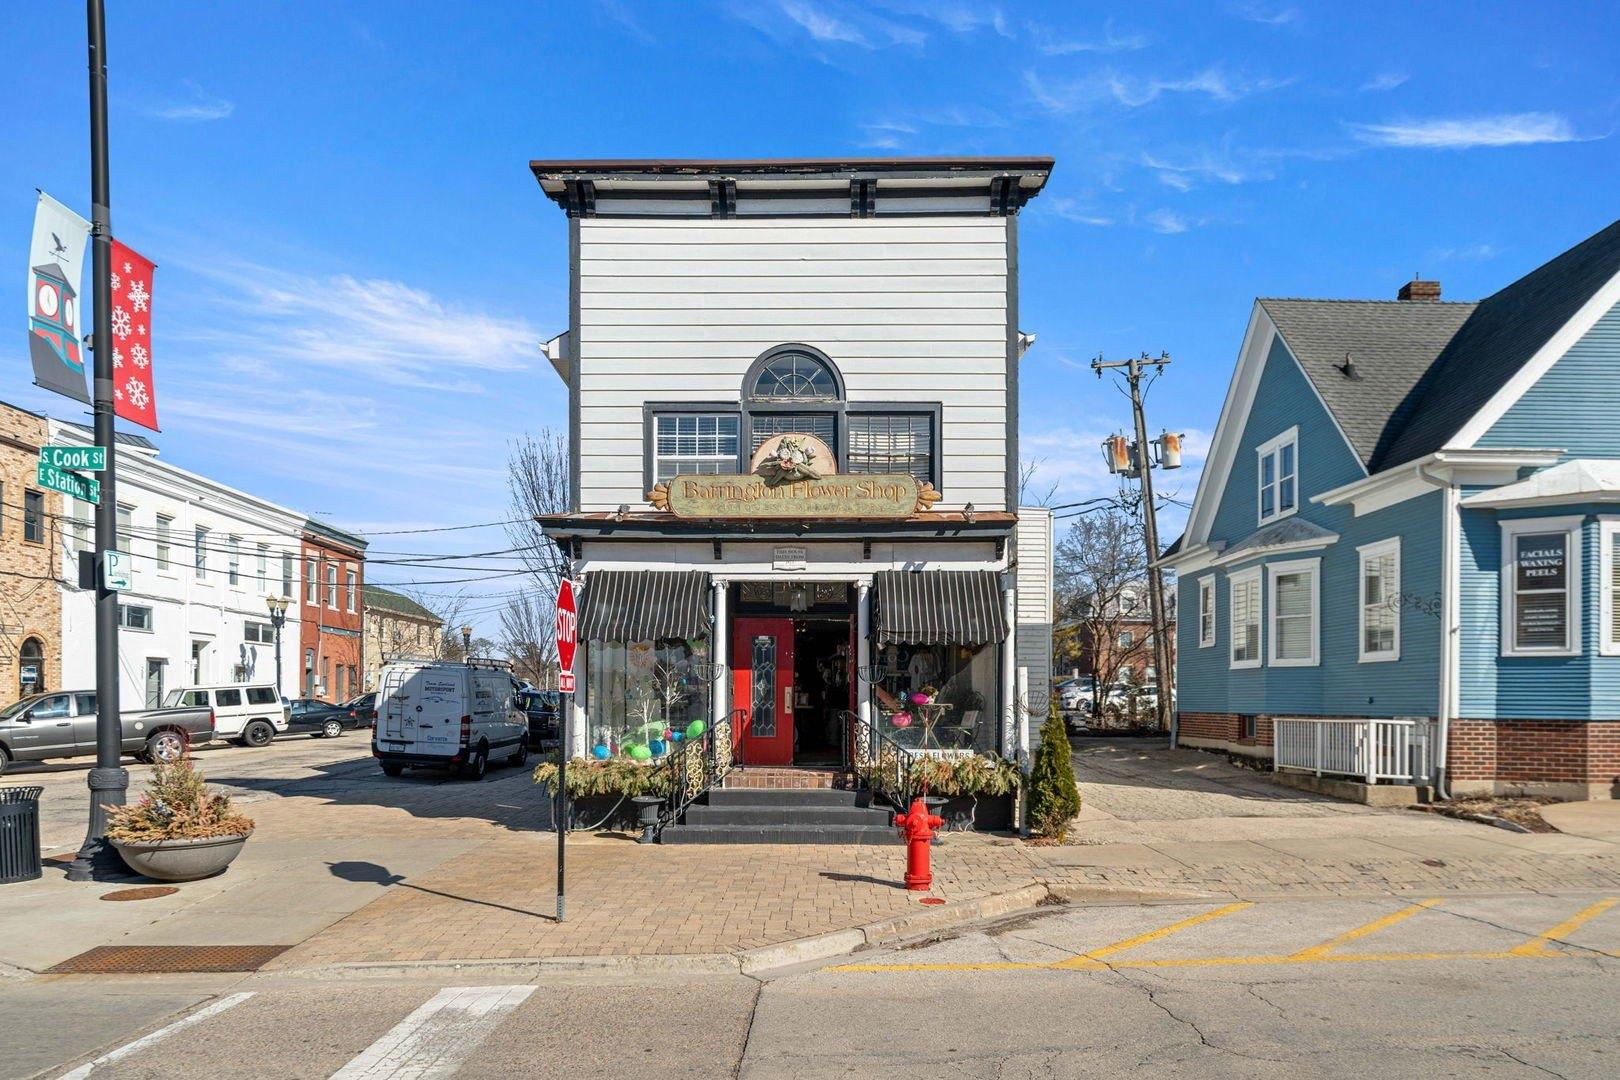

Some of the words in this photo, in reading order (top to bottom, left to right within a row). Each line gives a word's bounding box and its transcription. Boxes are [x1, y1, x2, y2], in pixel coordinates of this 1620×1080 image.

[53, 449, 90, 467] Cook
[93, 452, 103, 464] St
[39, 468, 45, 481] E
[47, 469, 87, 498] Station
[89, 484, 97, 497] St
[682, 480, 785, 503] Barrington
[789, 480, 851, 499] Flower
[856, 480, 907, 502] Shop
[1520, 549, 1563, 559] FACIALS
[1520, 558, 1563, 568] WAXING
[1525, 568, 1558, 577] PEELS
[557, 608, 576, 643] STOP
